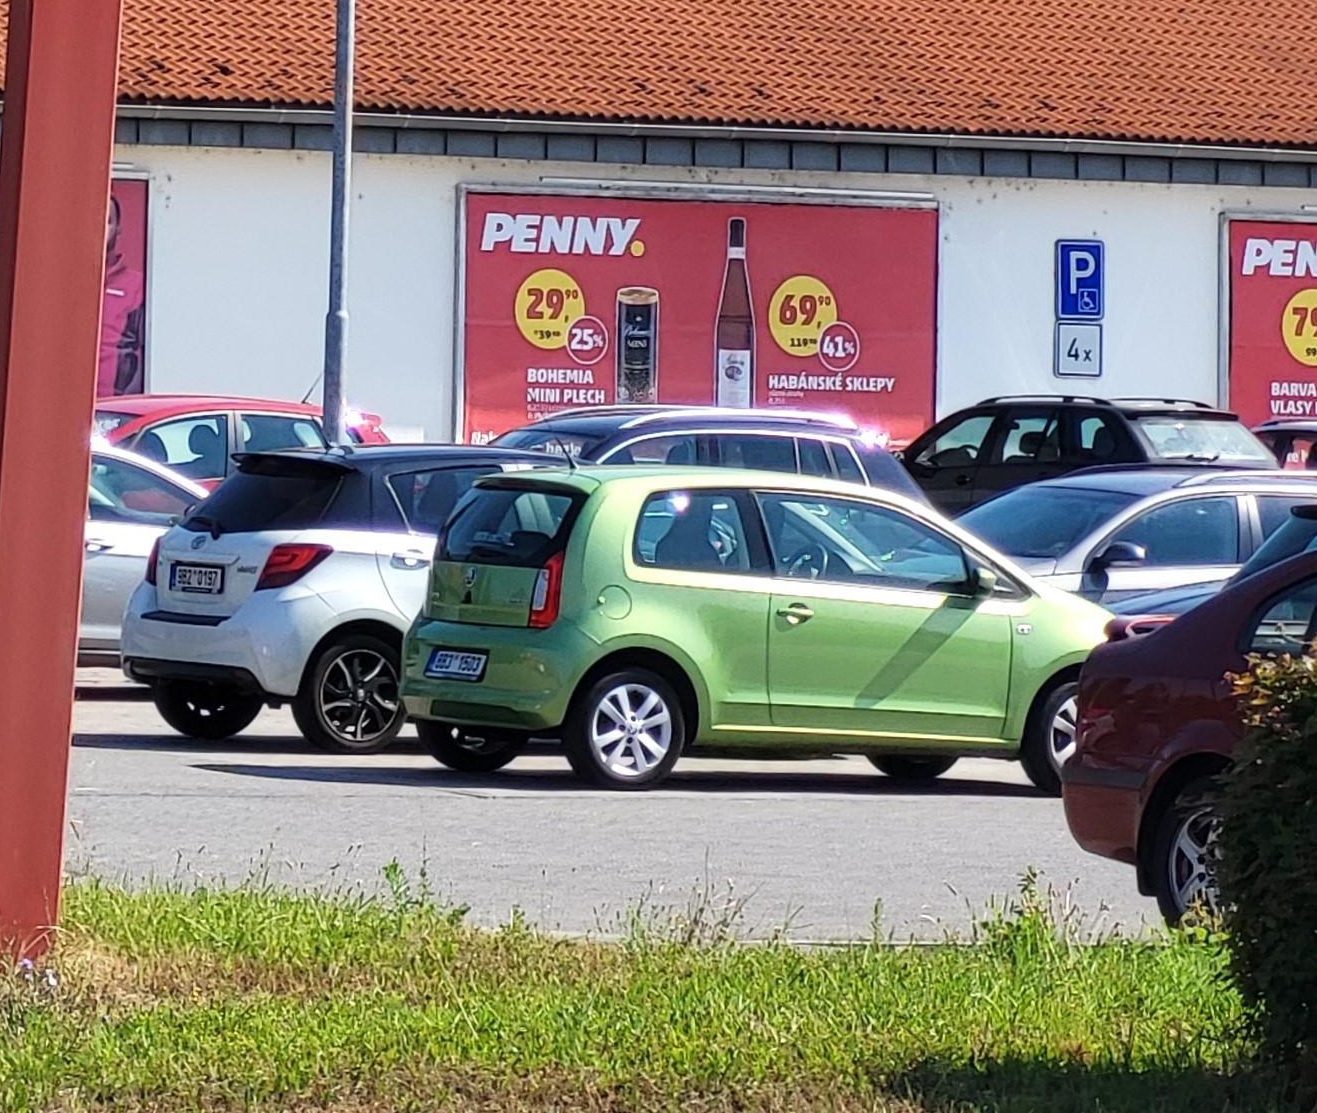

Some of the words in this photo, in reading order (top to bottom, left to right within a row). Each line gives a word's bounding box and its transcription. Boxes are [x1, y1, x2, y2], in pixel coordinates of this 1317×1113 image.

[1069, 251, 1096, 295] P
[571, 328, 604, 350] 25%
[822, 336, 855, 358] 41%
[527, 368, 594, 384] BOHEMIA
[769, 372, 843, 390] HABÁNSKÉ
[846, 376, 895, 393] SKLEPY
[527, 388, 560, 402] MINI
[563, 389, 605, 403] PLECH
[1270, 400, 1311, 415] VLASY
[197, 569, 218, 586] 0197
